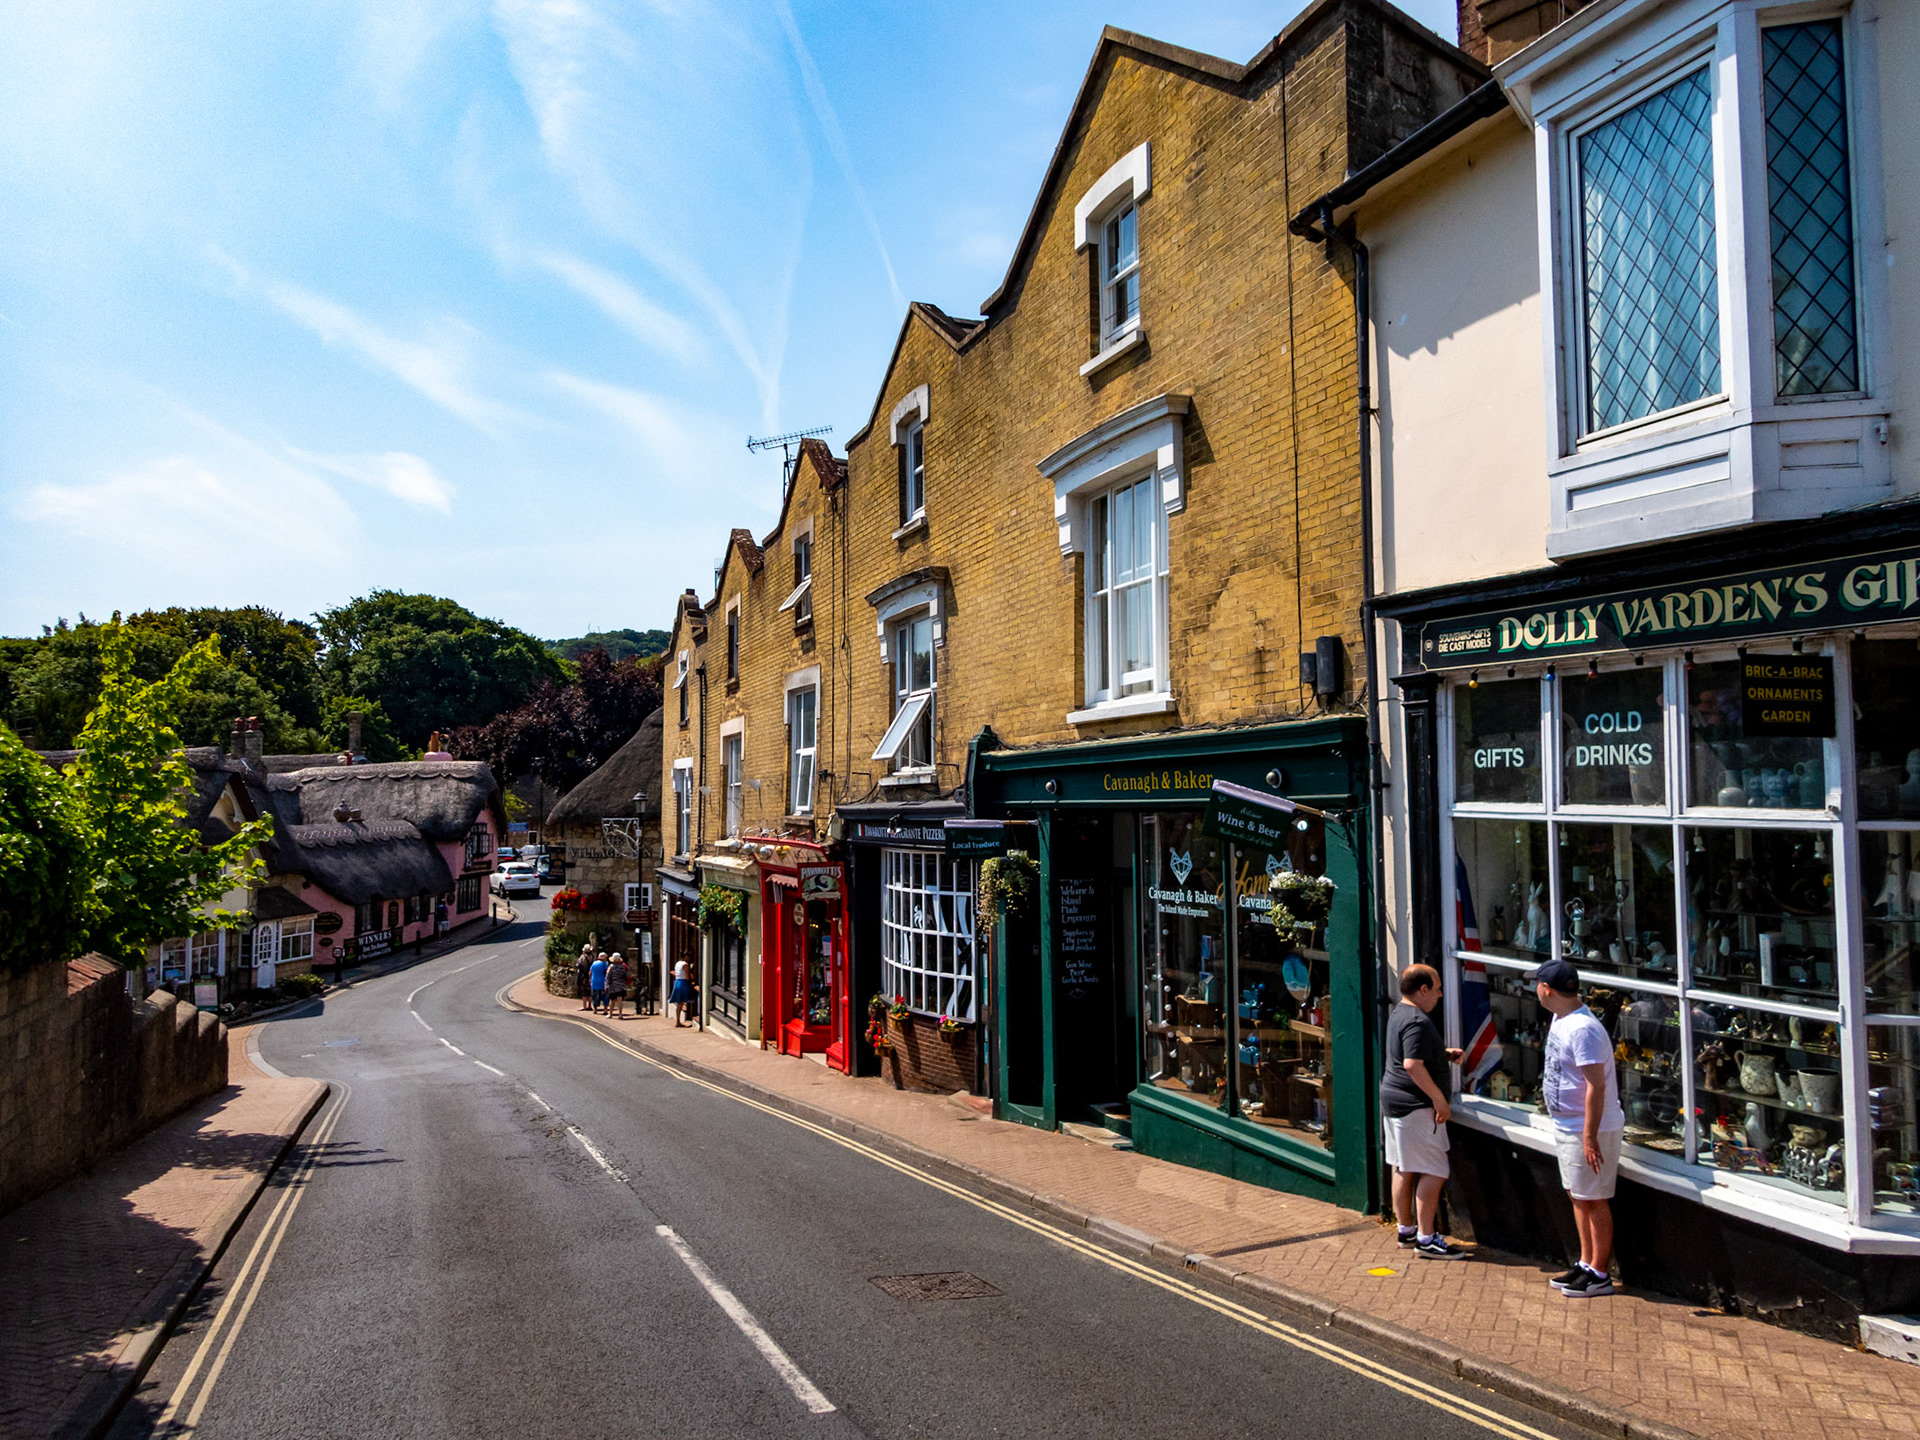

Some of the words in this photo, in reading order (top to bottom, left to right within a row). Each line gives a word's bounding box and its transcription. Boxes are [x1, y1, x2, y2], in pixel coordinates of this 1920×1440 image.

[1500, 602, 1605, 649] DOLLY
[1612, 571, 1829, 638] VARDEN'S
[1449, 641, 1465, 651] CAST
[1466, 638, 1492, 649] MODELS
[1745, 665, 1823, 679] BRIC-A-BRAC
[1747, 687, 1823, 700] ORNAMENTS
[1585, 711, 1642, 735] COLD
[1762, 710, 1811, 723] GARDEN
[1474, 747, 1524, 769] GIFTS
[1575, 743, 1652, 767] DRINKS
[1104, 771, 1159, 793] Cavanagh
[1161, 771, 1171, 790] &
[1174, 770, 1213, 789] Baker
[1218, 811, 1245, 828] Wine
[1247, 821, 1255, 831] &
[1258, 823, 1281, 838] Beer
[953, 841, 971, 849] Local
[570, 847, 622, 859] VILLAGE
[1148, 886, 1185, 904] Cavanagh
[1186, 889, 1193, 902] &
[1194, 890, 1218, 904] Baker
[1239, 894, 1272, 909] Cavana
[358, 931, 392, 945] WINNERS
